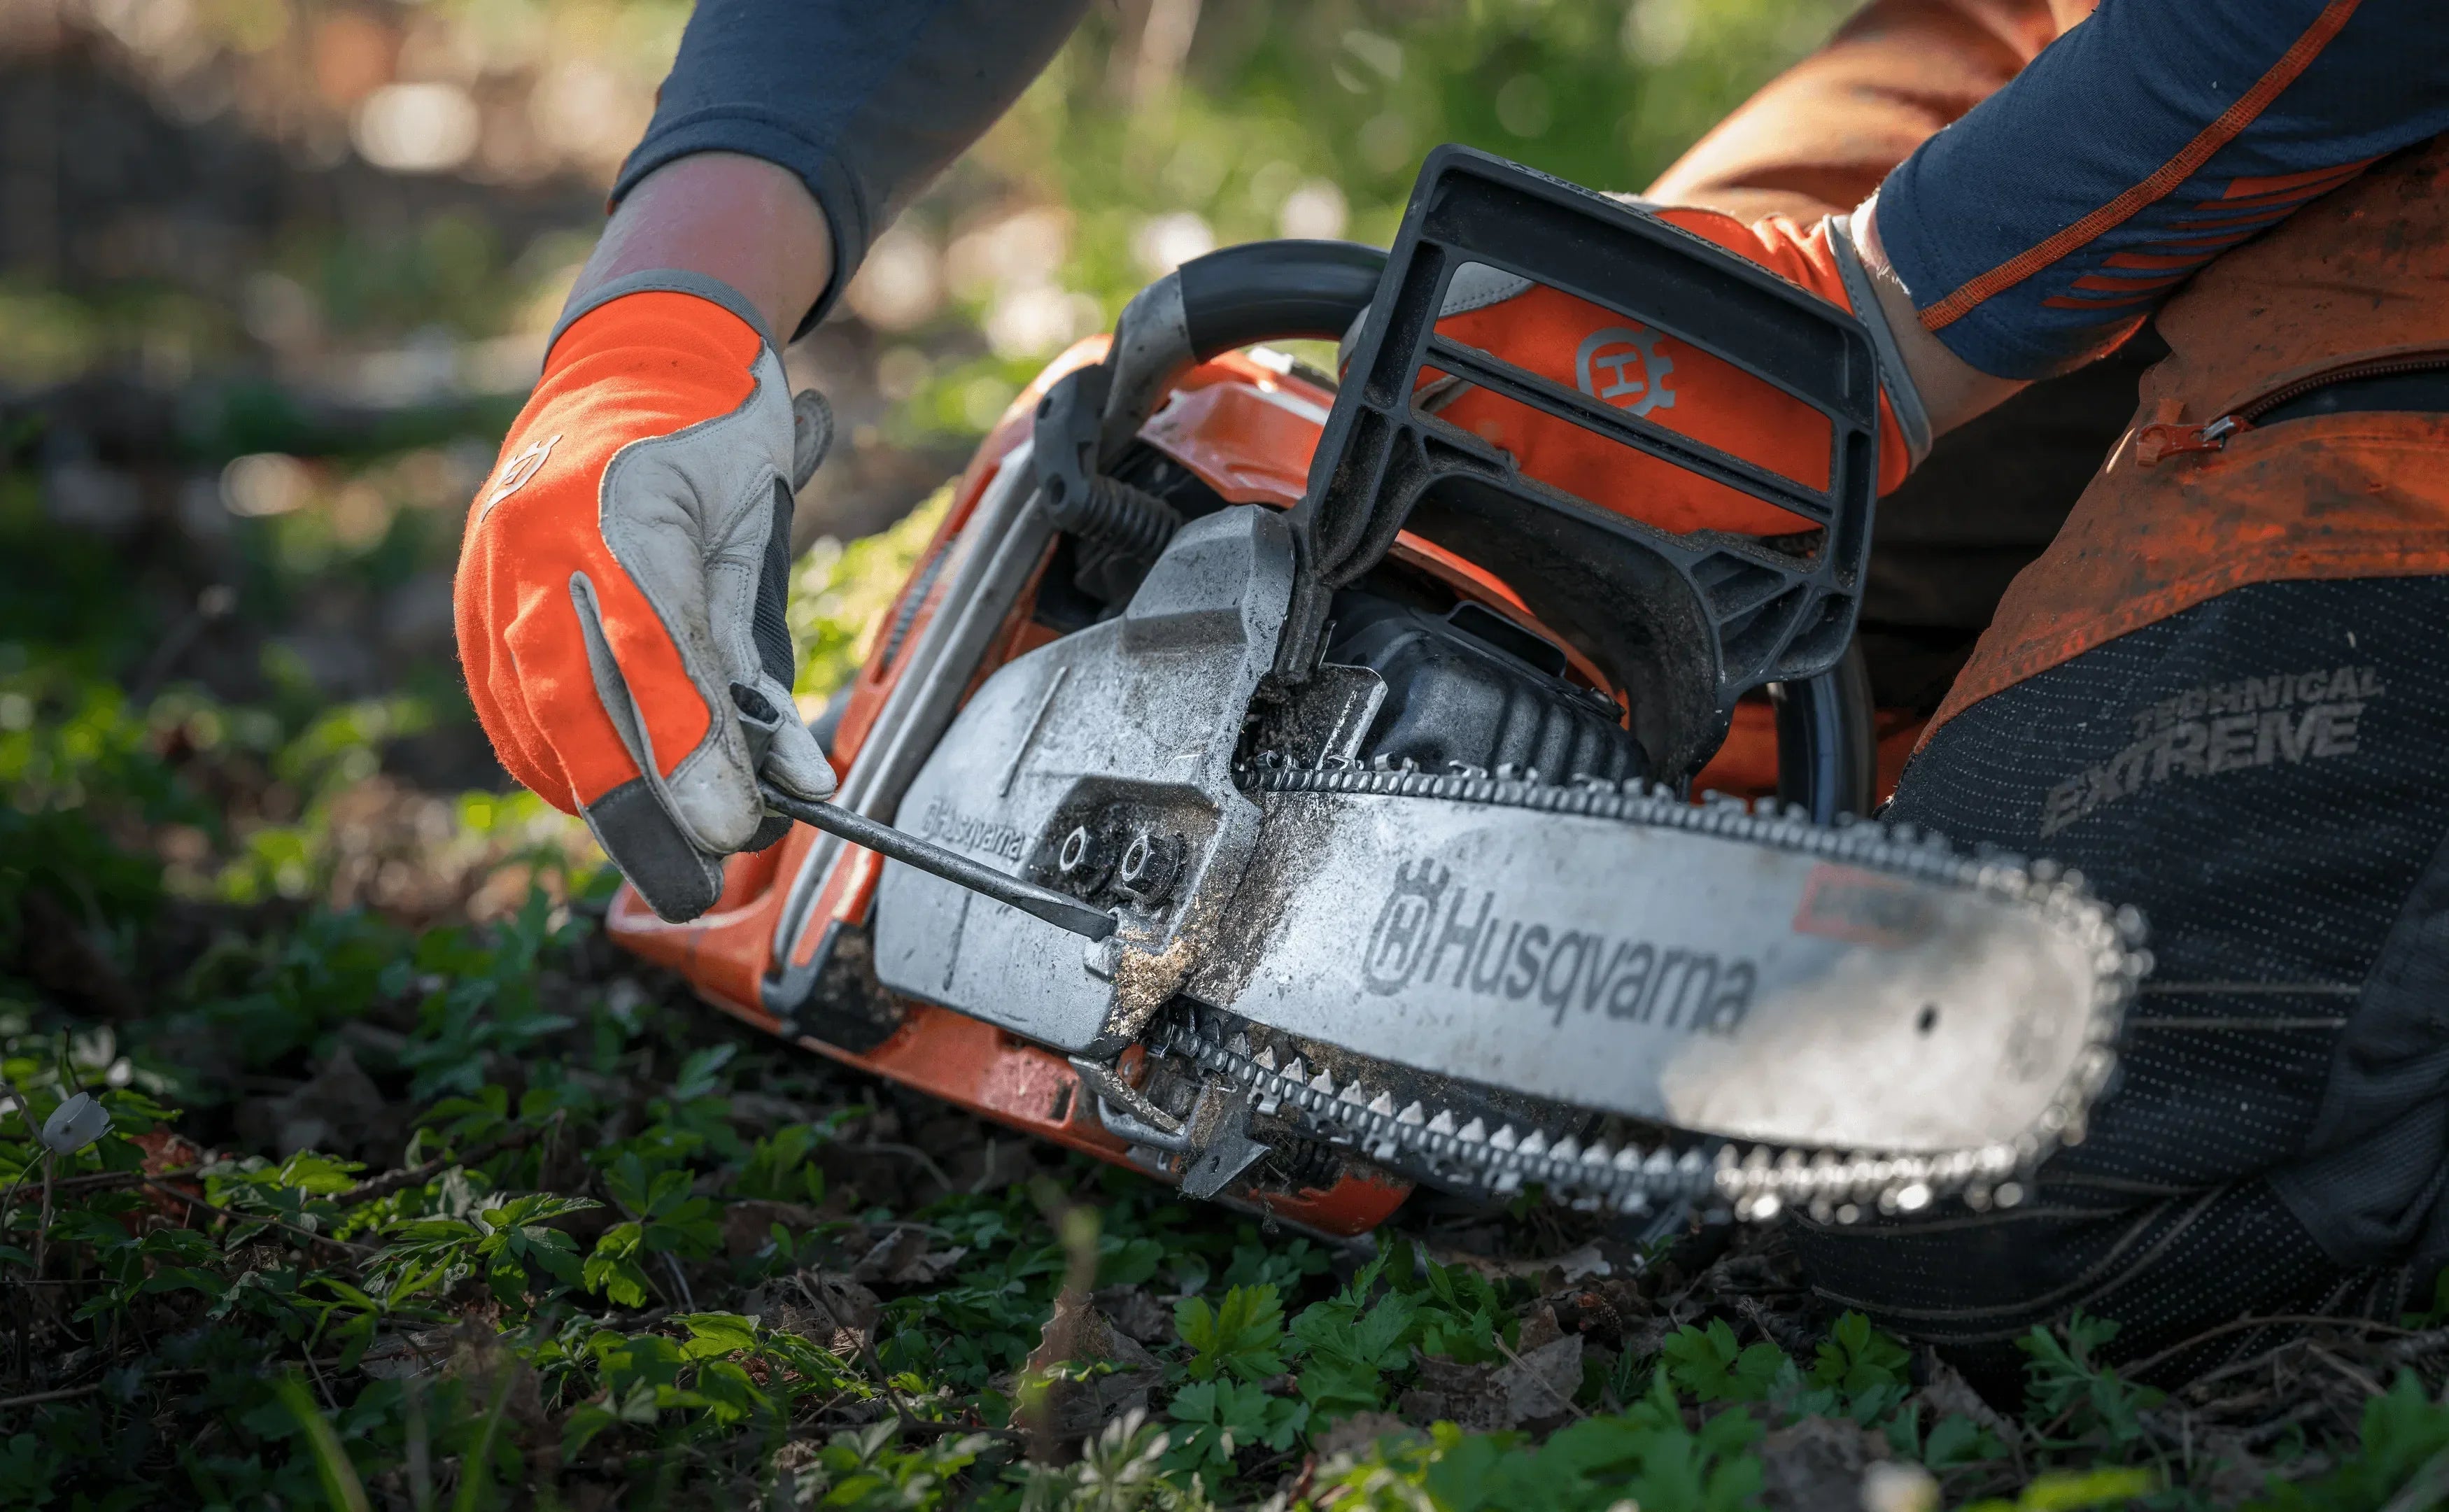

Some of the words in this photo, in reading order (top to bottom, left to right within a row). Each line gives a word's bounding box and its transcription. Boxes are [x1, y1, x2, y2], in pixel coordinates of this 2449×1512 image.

[1538, 173, 1615, 204] RESET
[2132, 665, 2385, 739] TECHNICAL
[1423, 886, 1757, 1038] Husqvarna
